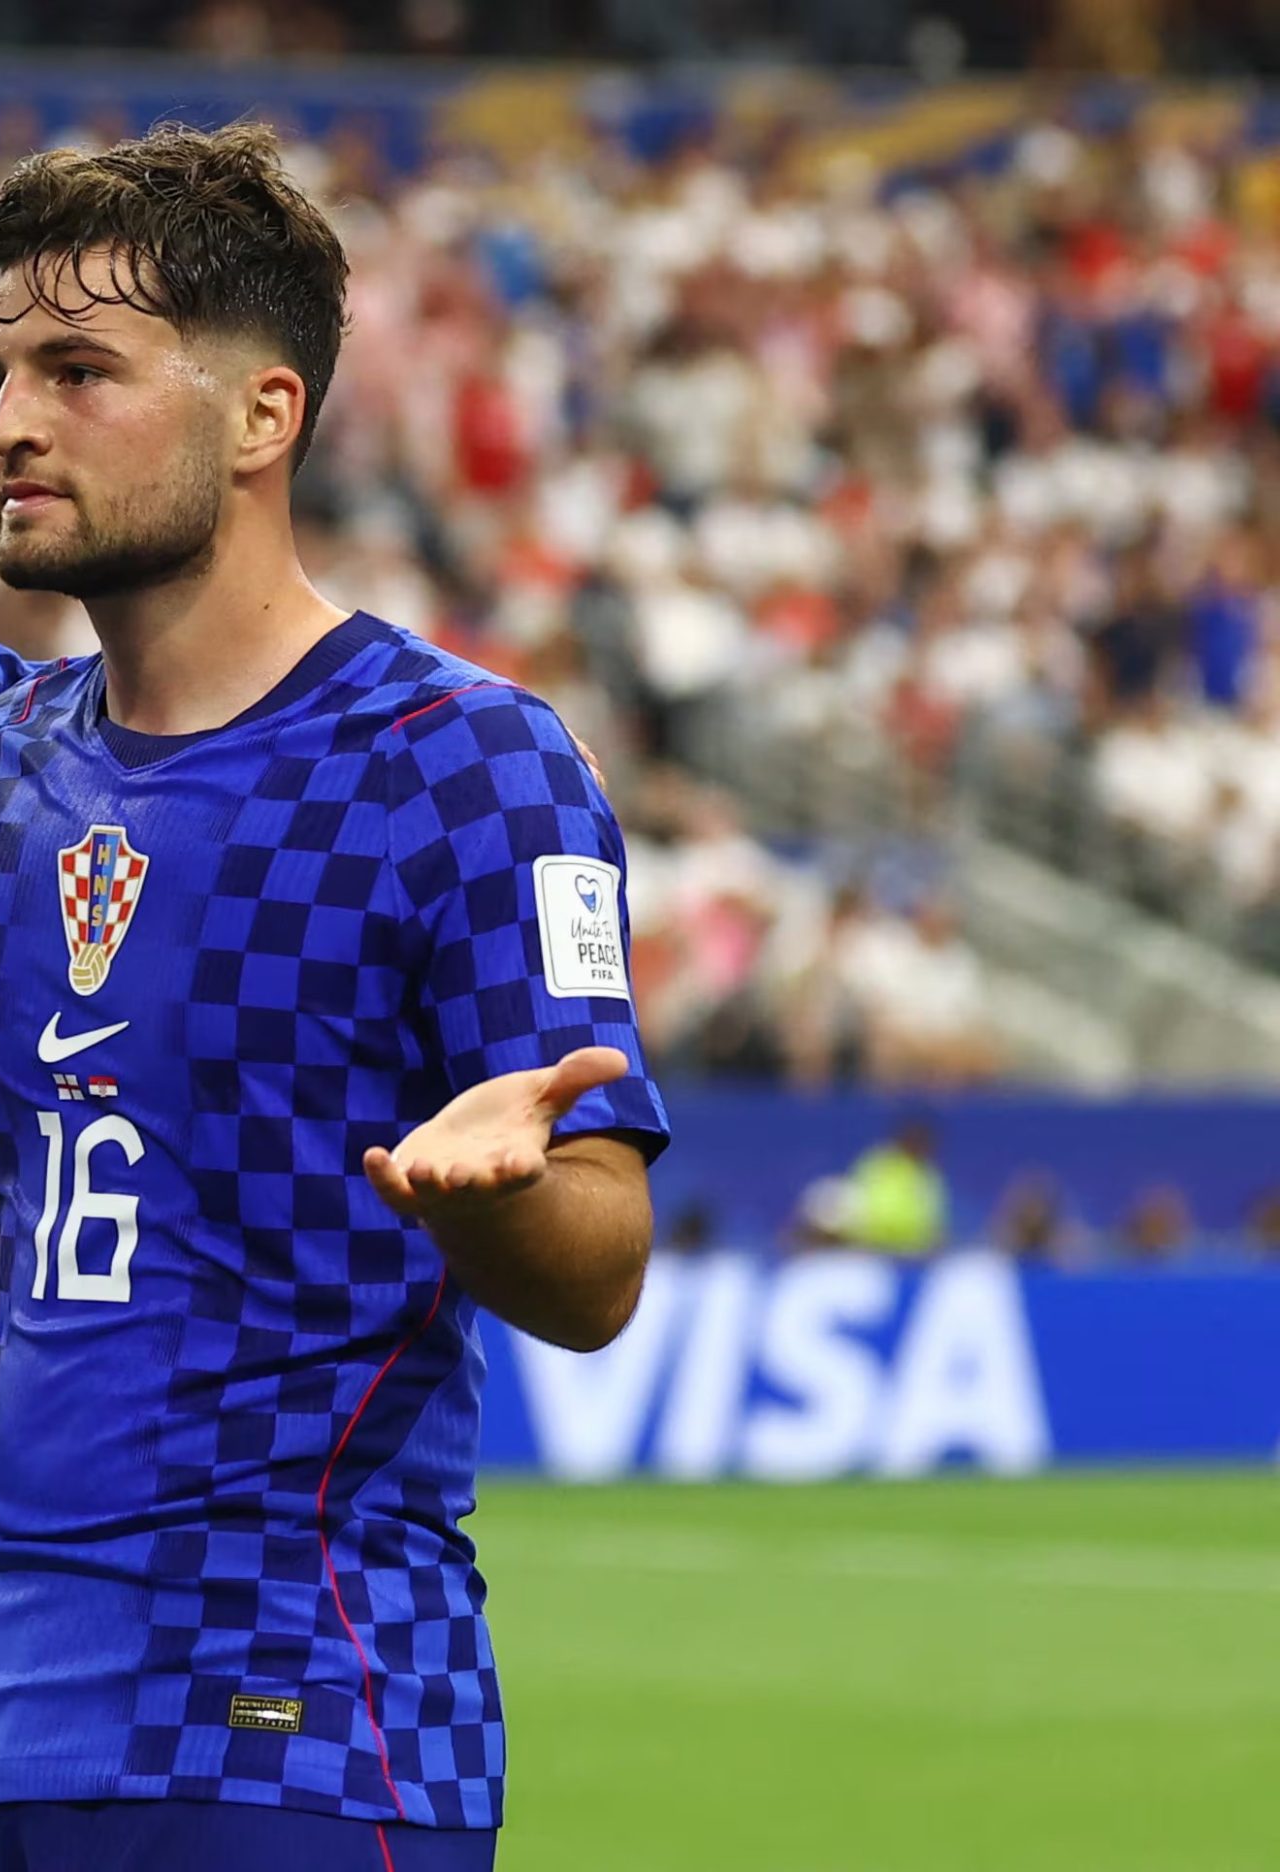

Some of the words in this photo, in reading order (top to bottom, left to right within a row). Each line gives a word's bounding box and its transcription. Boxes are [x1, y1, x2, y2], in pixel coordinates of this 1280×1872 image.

[91, 844, 111, 927] HNS
[577, 942, 619, 967] PEACE
[591, 969, 615, 980] FIFA
[31, 1111, 146, 1303] 16
[505, 1253, 1054, 1480] VISA
